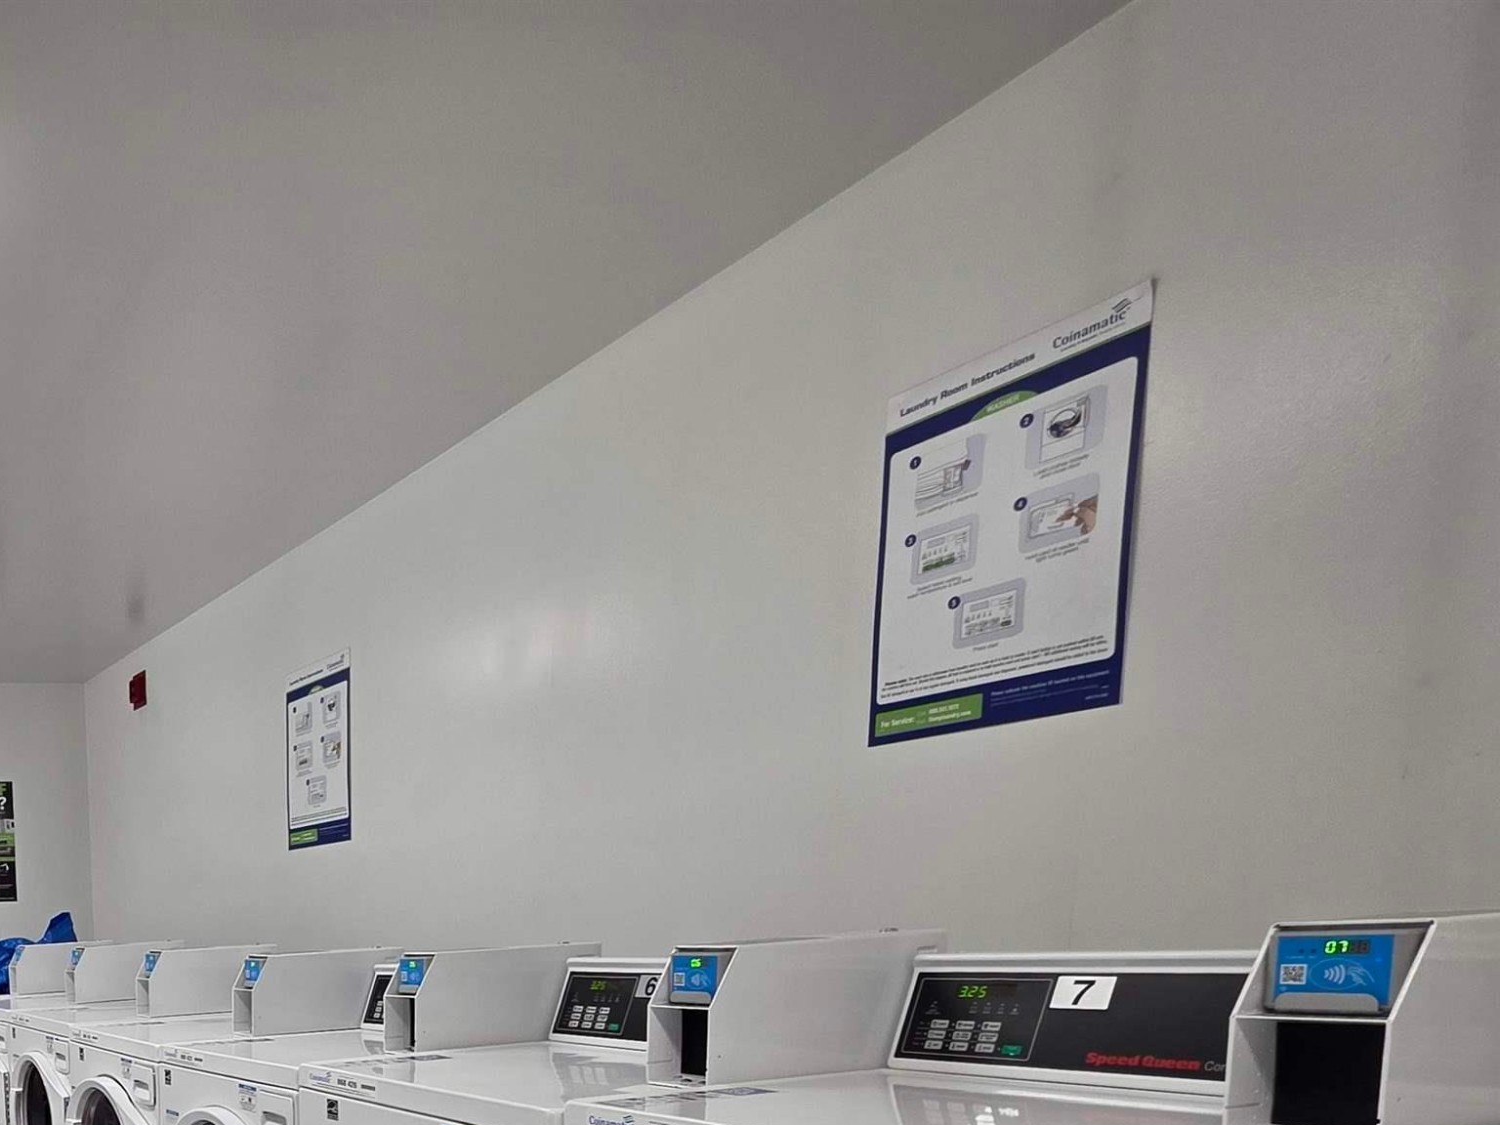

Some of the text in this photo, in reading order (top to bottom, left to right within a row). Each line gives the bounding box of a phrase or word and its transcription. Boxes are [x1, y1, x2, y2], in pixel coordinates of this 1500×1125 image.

[1053, 309, 1126, 349] Coinamatic
[900, 352, 1035, 418] Laundry Room Instructions
[1324, 940, 1349, 954] 07
[645, 977, 658, 996] 6
[1071, 980, 1096, 1005] 7
[1086, 1052, 1141, 1066] Speed
[1142, 1055, 1200, 1070] Queen
